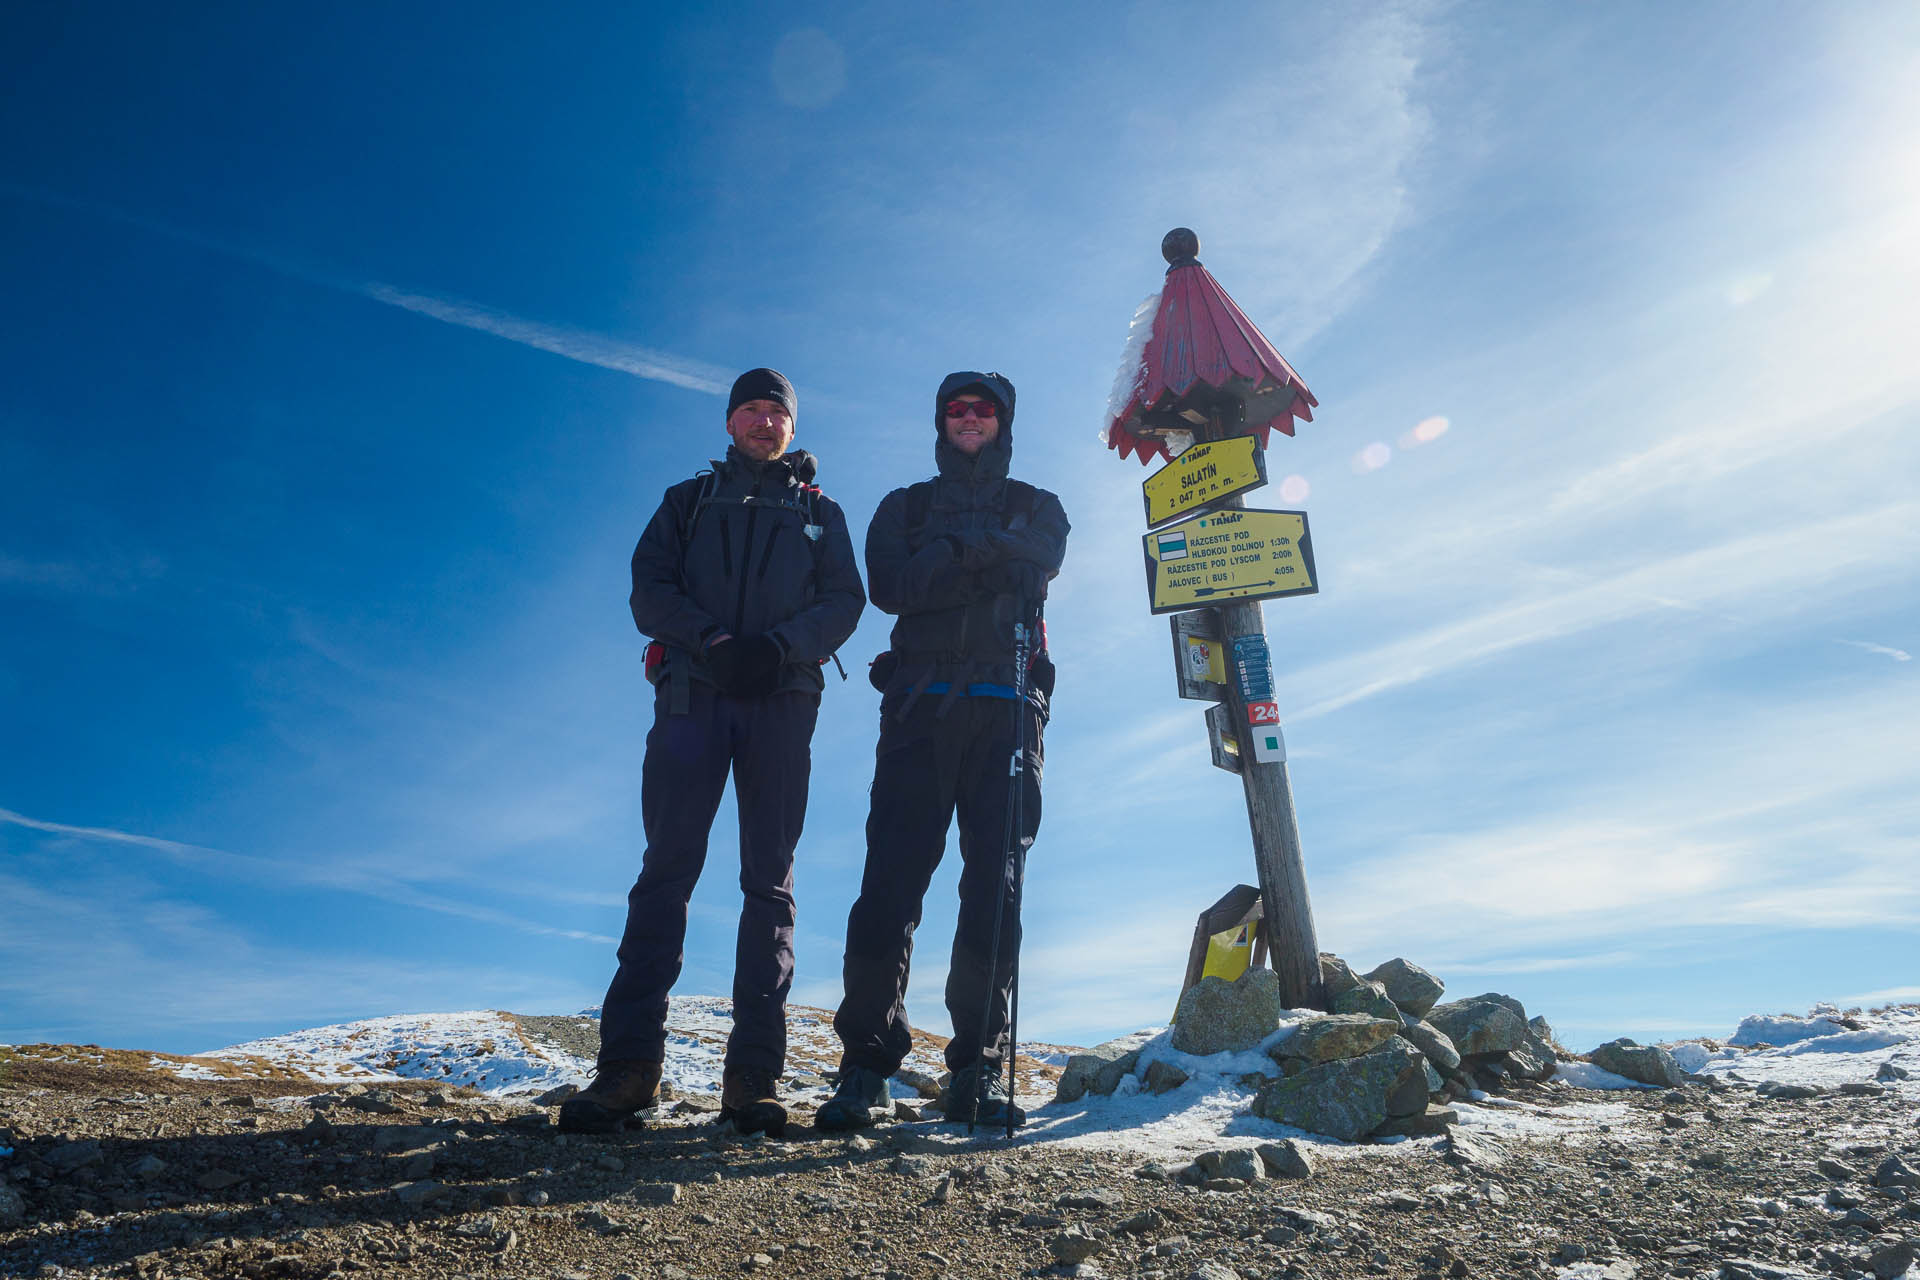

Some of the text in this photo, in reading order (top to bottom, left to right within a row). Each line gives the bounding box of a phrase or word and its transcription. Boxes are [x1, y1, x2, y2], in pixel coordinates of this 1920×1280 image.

[1188, 446, 1211, 462] TANAP
[1181, 463, 1216, 488] SALATÍN
[1170, 477, 1234, 508] 2 047 m n. m.
[1210, 514, 1244, 526] TANAP
[1190, 531, 1250, 547] RÁZCESTIE POD
[1192, 538, 1290, 558] HLBOKOU DOLINOU 1:30h
[1211, 559, 1226, 568] POD
[1230, 554, 1261, 566] LYSCOM
[1272, 551, 1292, 560] 2:00h
[1168, 576, 1201, 588] JALOVEC
[1212, 572, 1228, 582] BUS
[1274, 566, 1294, 576] 4:05h
[1254, 706, 1277, 721] 24
